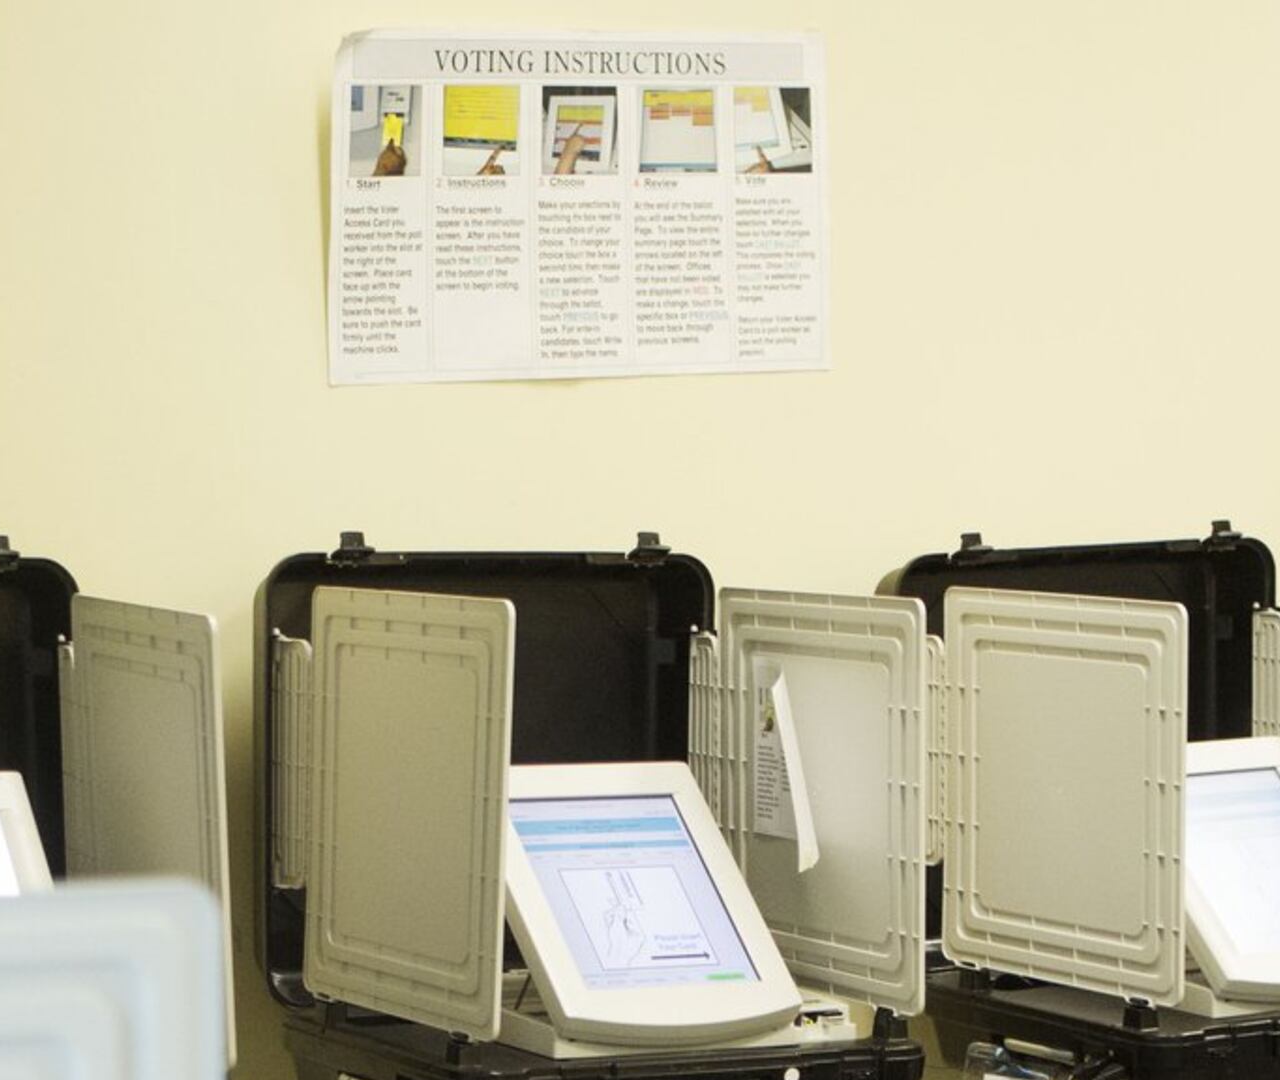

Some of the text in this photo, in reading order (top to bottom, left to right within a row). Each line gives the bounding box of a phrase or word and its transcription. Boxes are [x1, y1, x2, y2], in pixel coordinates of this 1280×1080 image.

[435, 49, 727, 76] VOTING INSTRUCTIONS
[355, 179, 381, 189] Start
[447, 178, 507, 188] Instructions
